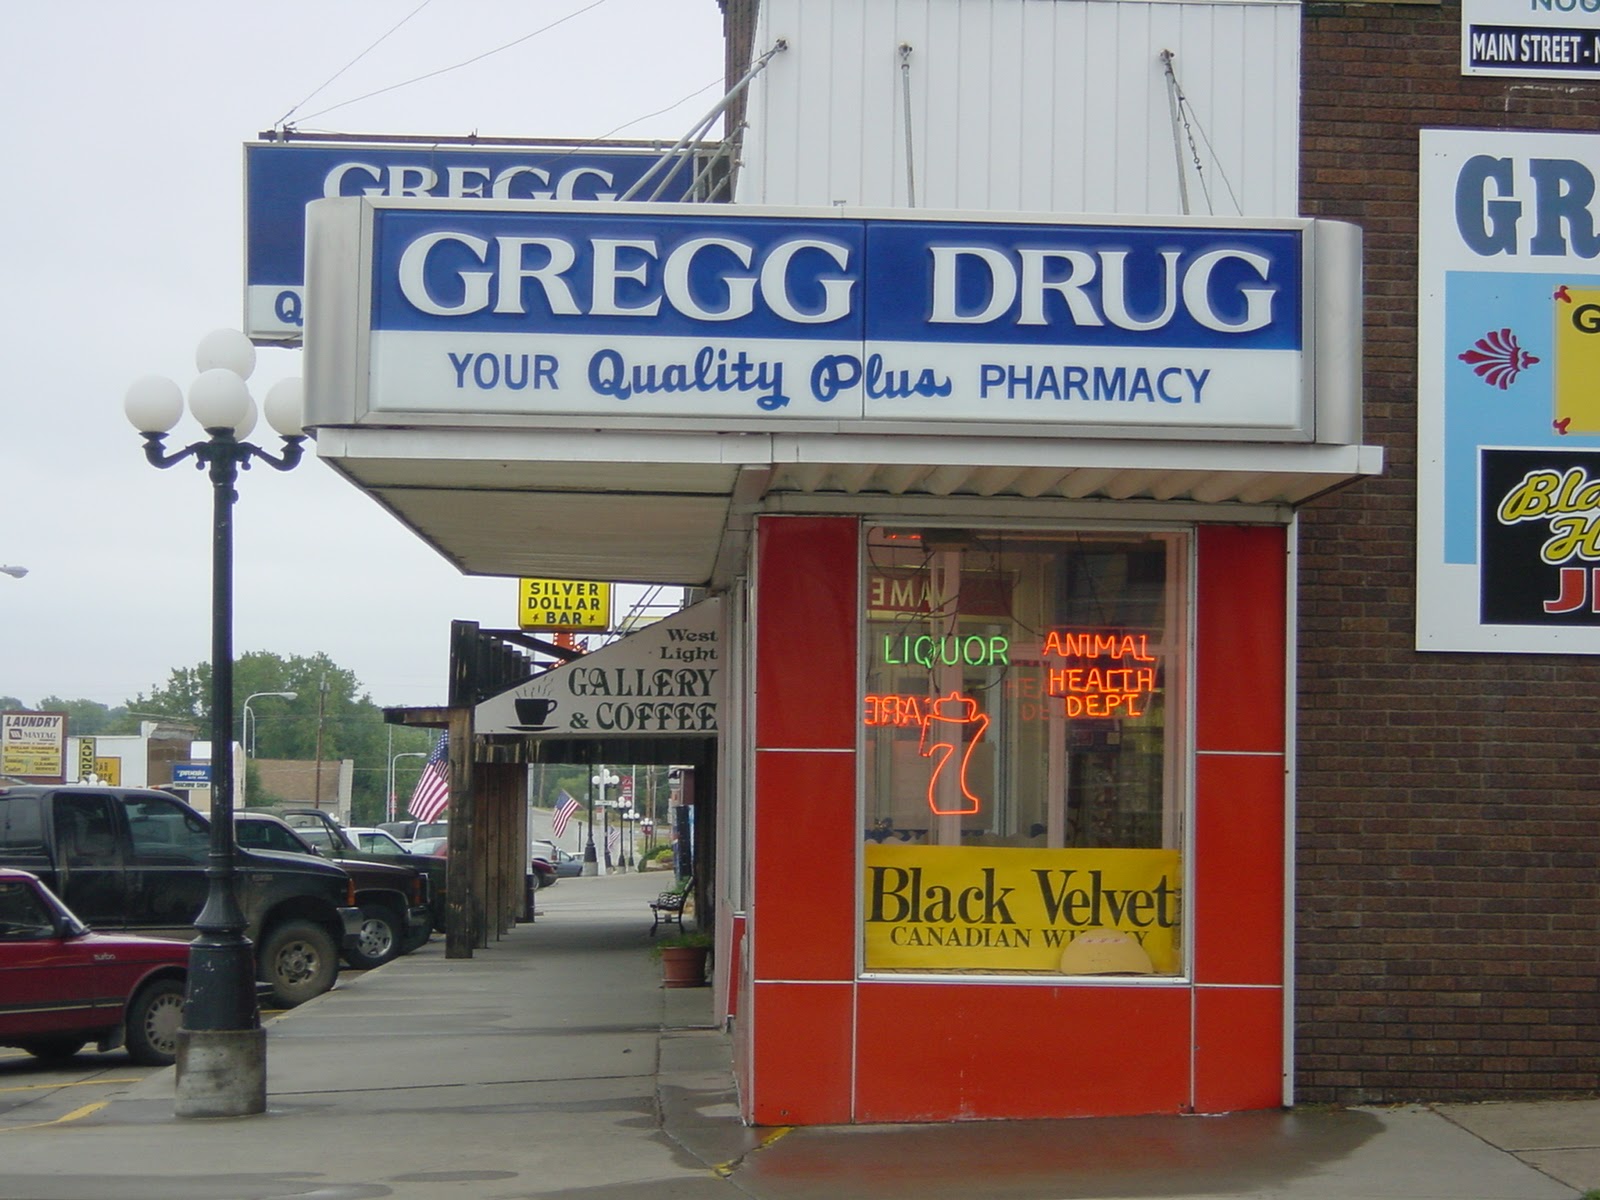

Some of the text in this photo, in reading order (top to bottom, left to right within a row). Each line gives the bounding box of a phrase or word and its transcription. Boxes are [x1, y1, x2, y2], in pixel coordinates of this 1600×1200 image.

[1472, 33, 1516, 61] MAIN
[1520, 34, 1580, 63] STREET
[399, 231, 1276, 333] GREGG DRUG
[448, 345, 1211, 411] YOUR Quality Plus PHARMACY
[530, 582, 599, 596] SILVER
[528, 597, 600, 611] DOLLAR
[546, 612, 582, 625] BAR
[666, 628, 718, 642] West
[1043, 631, 1155, 661] ANIMAL
[660, 646, 718, 663] Light
[884, 635, 1009, 668] LIQUOR
[568, 667, 718, 697] GALLERY
[1049, 668, 1153, 695] HEALTH
[6, 716, 60, 727] LAUNDRY
[569, 702, 718, 730] & COFFEE
[23, 731, 56, 739] MAYTAG
[866, 866, 1180, 928] Black Velvet
[890, 926, 1032, 948] CANADIAN
